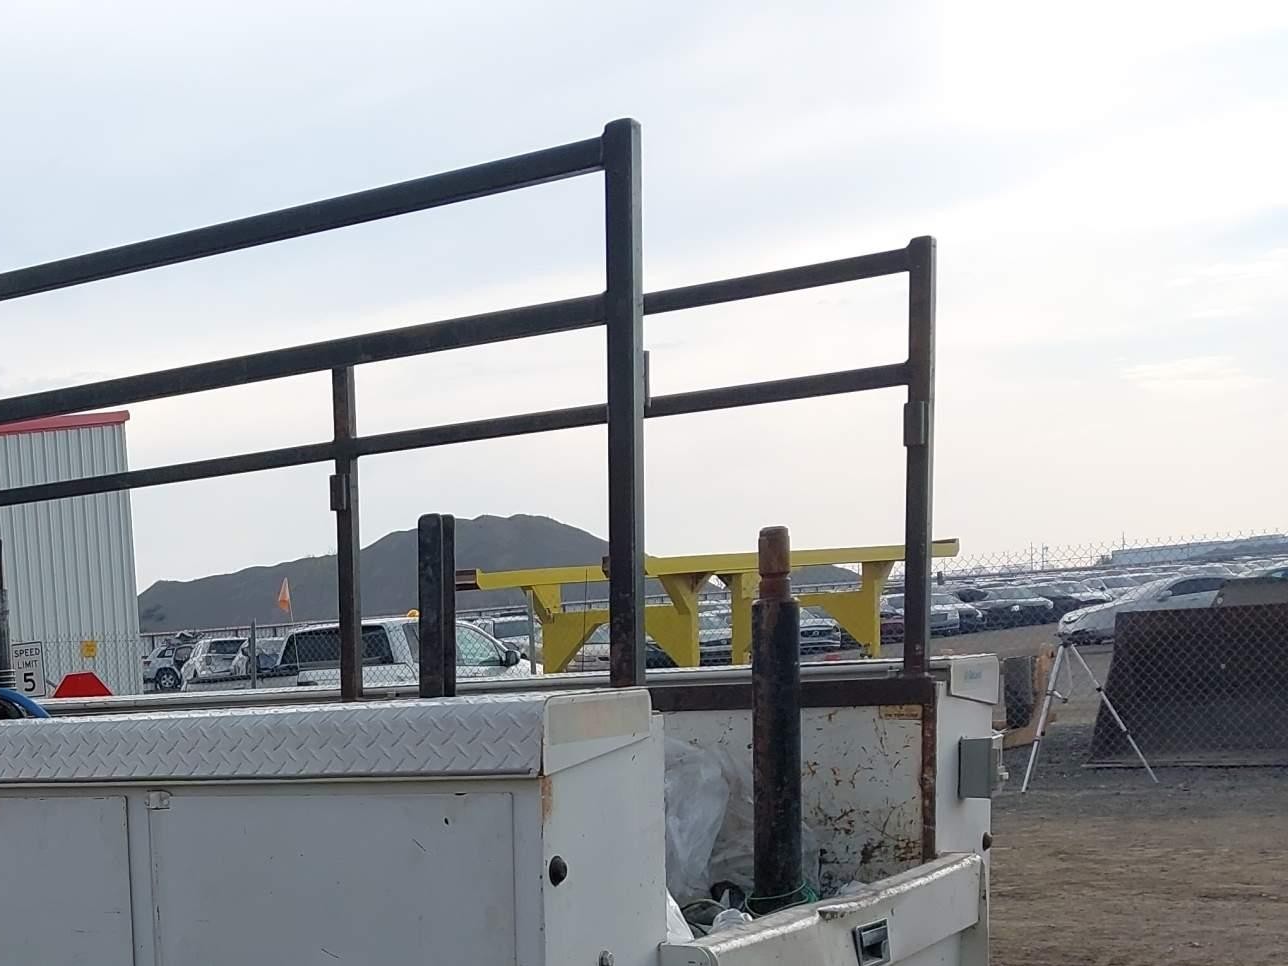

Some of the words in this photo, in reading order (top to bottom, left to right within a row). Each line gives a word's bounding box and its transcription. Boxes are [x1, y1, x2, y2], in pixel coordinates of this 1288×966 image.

[14, 648, 41, 658] SPEED
[17, 660, 38, 669] LIMIT
[23, 672, 36, 692] 5
